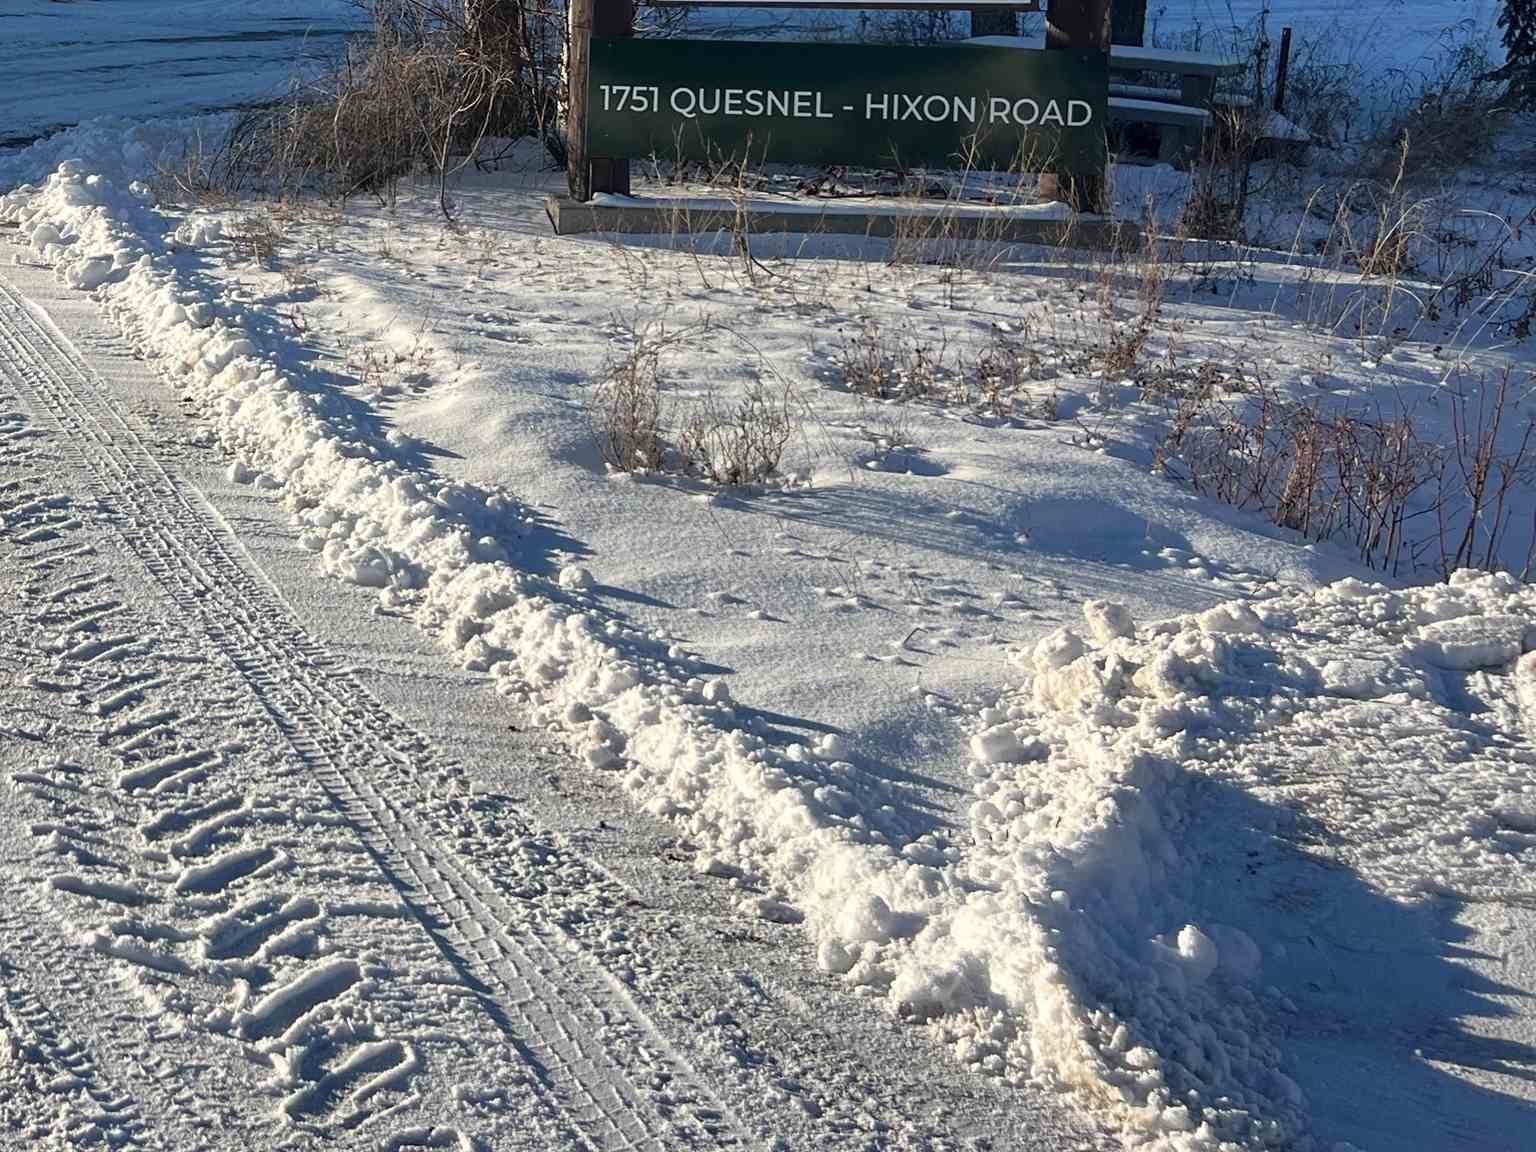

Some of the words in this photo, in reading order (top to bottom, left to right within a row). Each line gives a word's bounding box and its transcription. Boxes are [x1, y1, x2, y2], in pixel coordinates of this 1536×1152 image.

[599, 85, 659, 113] 1751
[670, 87, 834, 118] QUESNEL
[866, 93, 976, 123] HIXON
[989, 97, 1092, 127] ROAD
